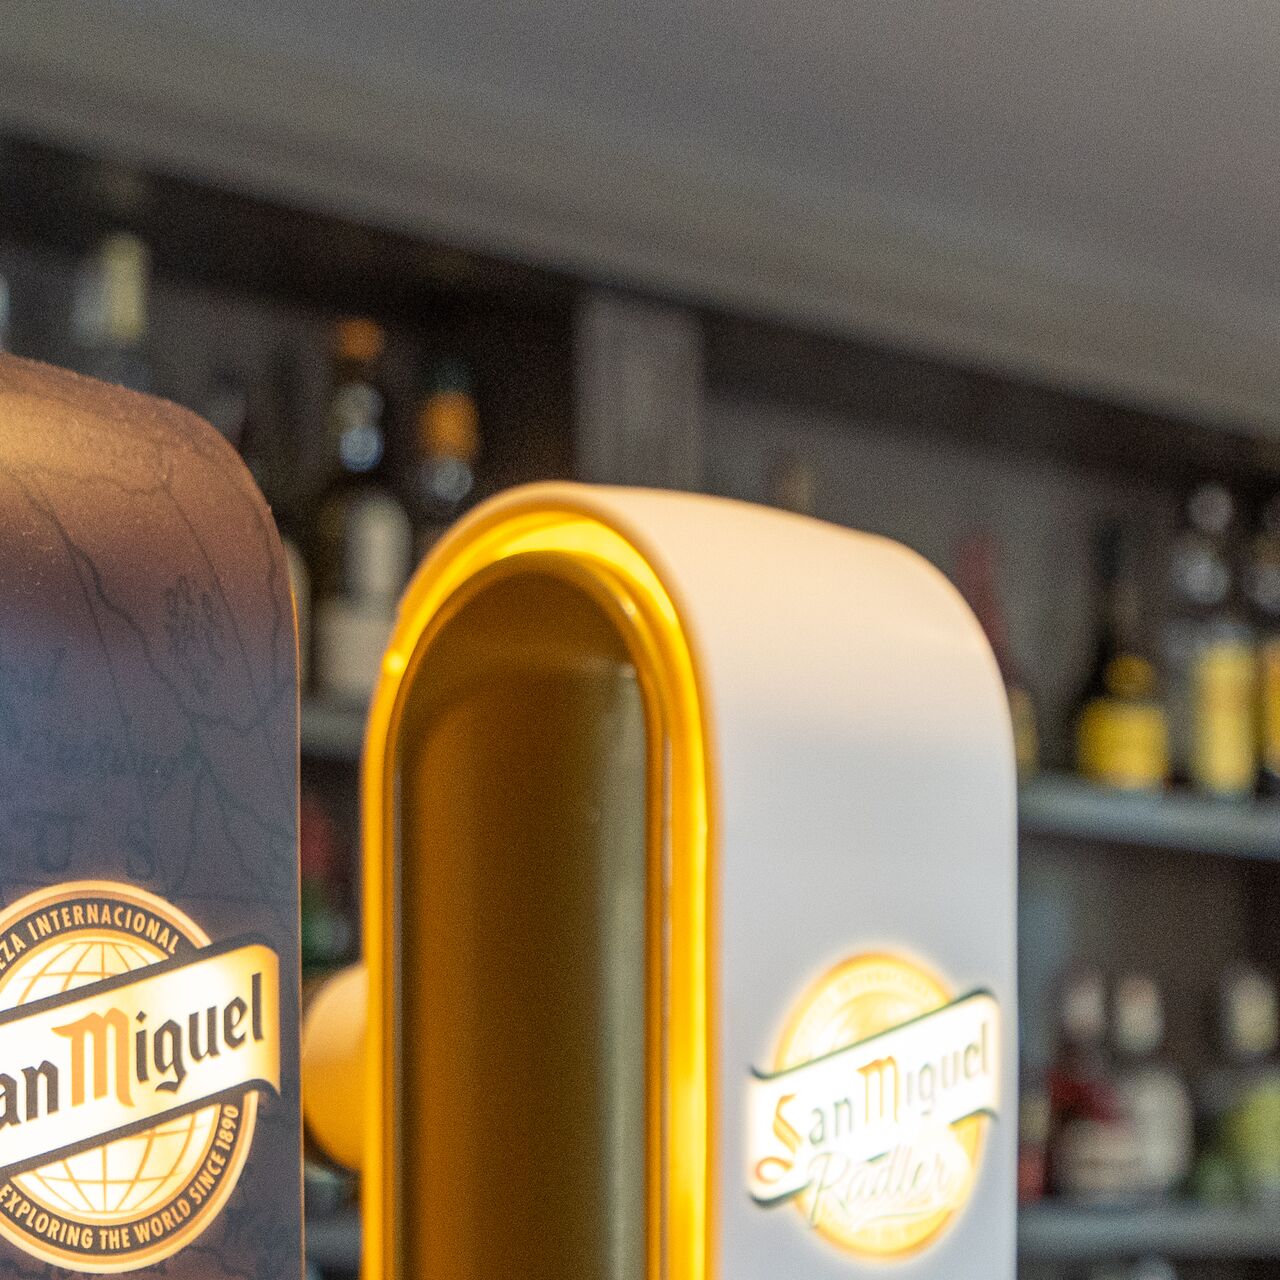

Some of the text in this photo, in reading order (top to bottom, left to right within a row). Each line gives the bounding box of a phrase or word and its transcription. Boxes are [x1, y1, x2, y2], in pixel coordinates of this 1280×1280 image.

[27, 903, 180, 955] INTERNACIONAL
[52, 973, 263, 1108] Miguel
[100, 1226, 130, 1250] THE
[133, 1201, 192, 1244] WORLD
[189, 1152, 227, 1205] SINCE
[216, 1106, 239, 1151] 1890
